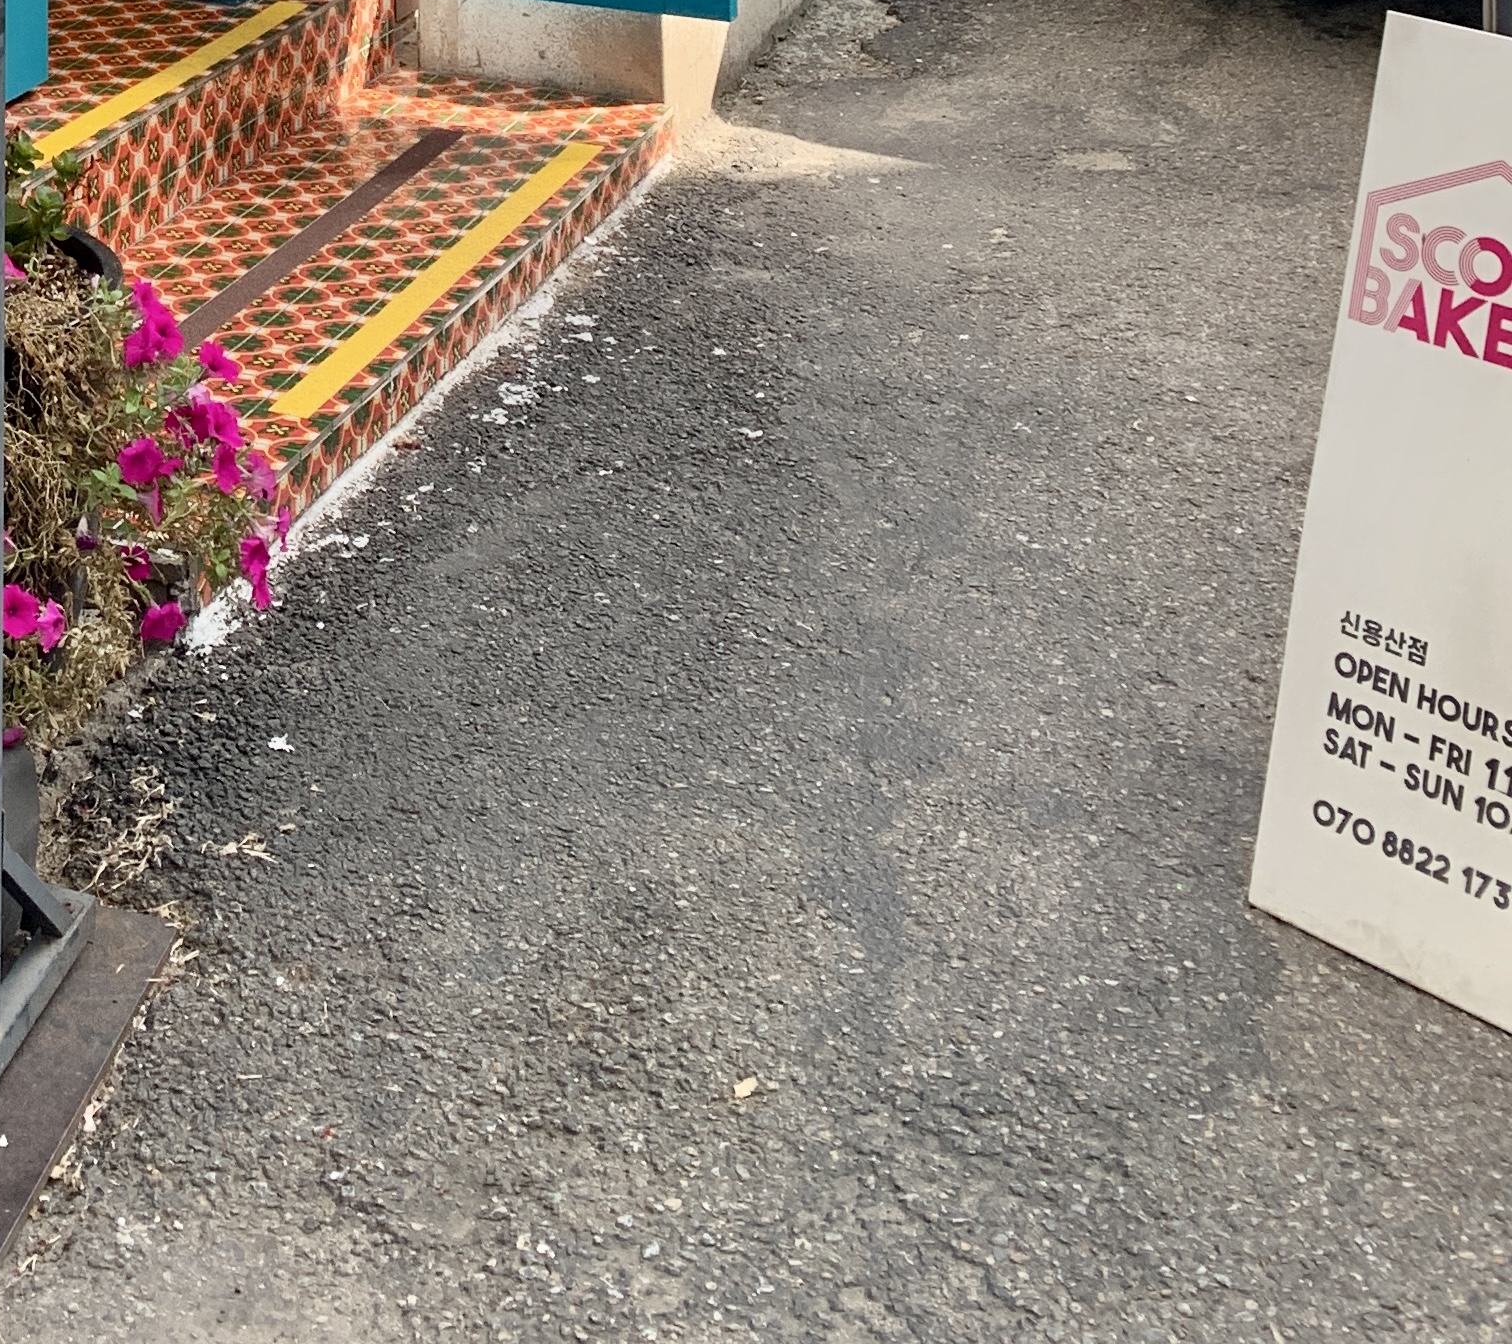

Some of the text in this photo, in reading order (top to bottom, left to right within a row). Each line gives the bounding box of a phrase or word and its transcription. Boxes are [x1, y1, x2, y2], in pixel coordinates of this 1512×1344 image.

[1334, 652, 1410, 703] OPEN
[1339, 610, 1429, 667] 신용산점
[1323, 728, 1373, 769] SAT
[1403, 763, 1465, 812] SUN
[1326, 692, 1396, 743] MON
[1428, 734, 1473, 777] FRI
[1312, 799, 1376, 846] 070
[1382, 830, 1451, 884] 8822
